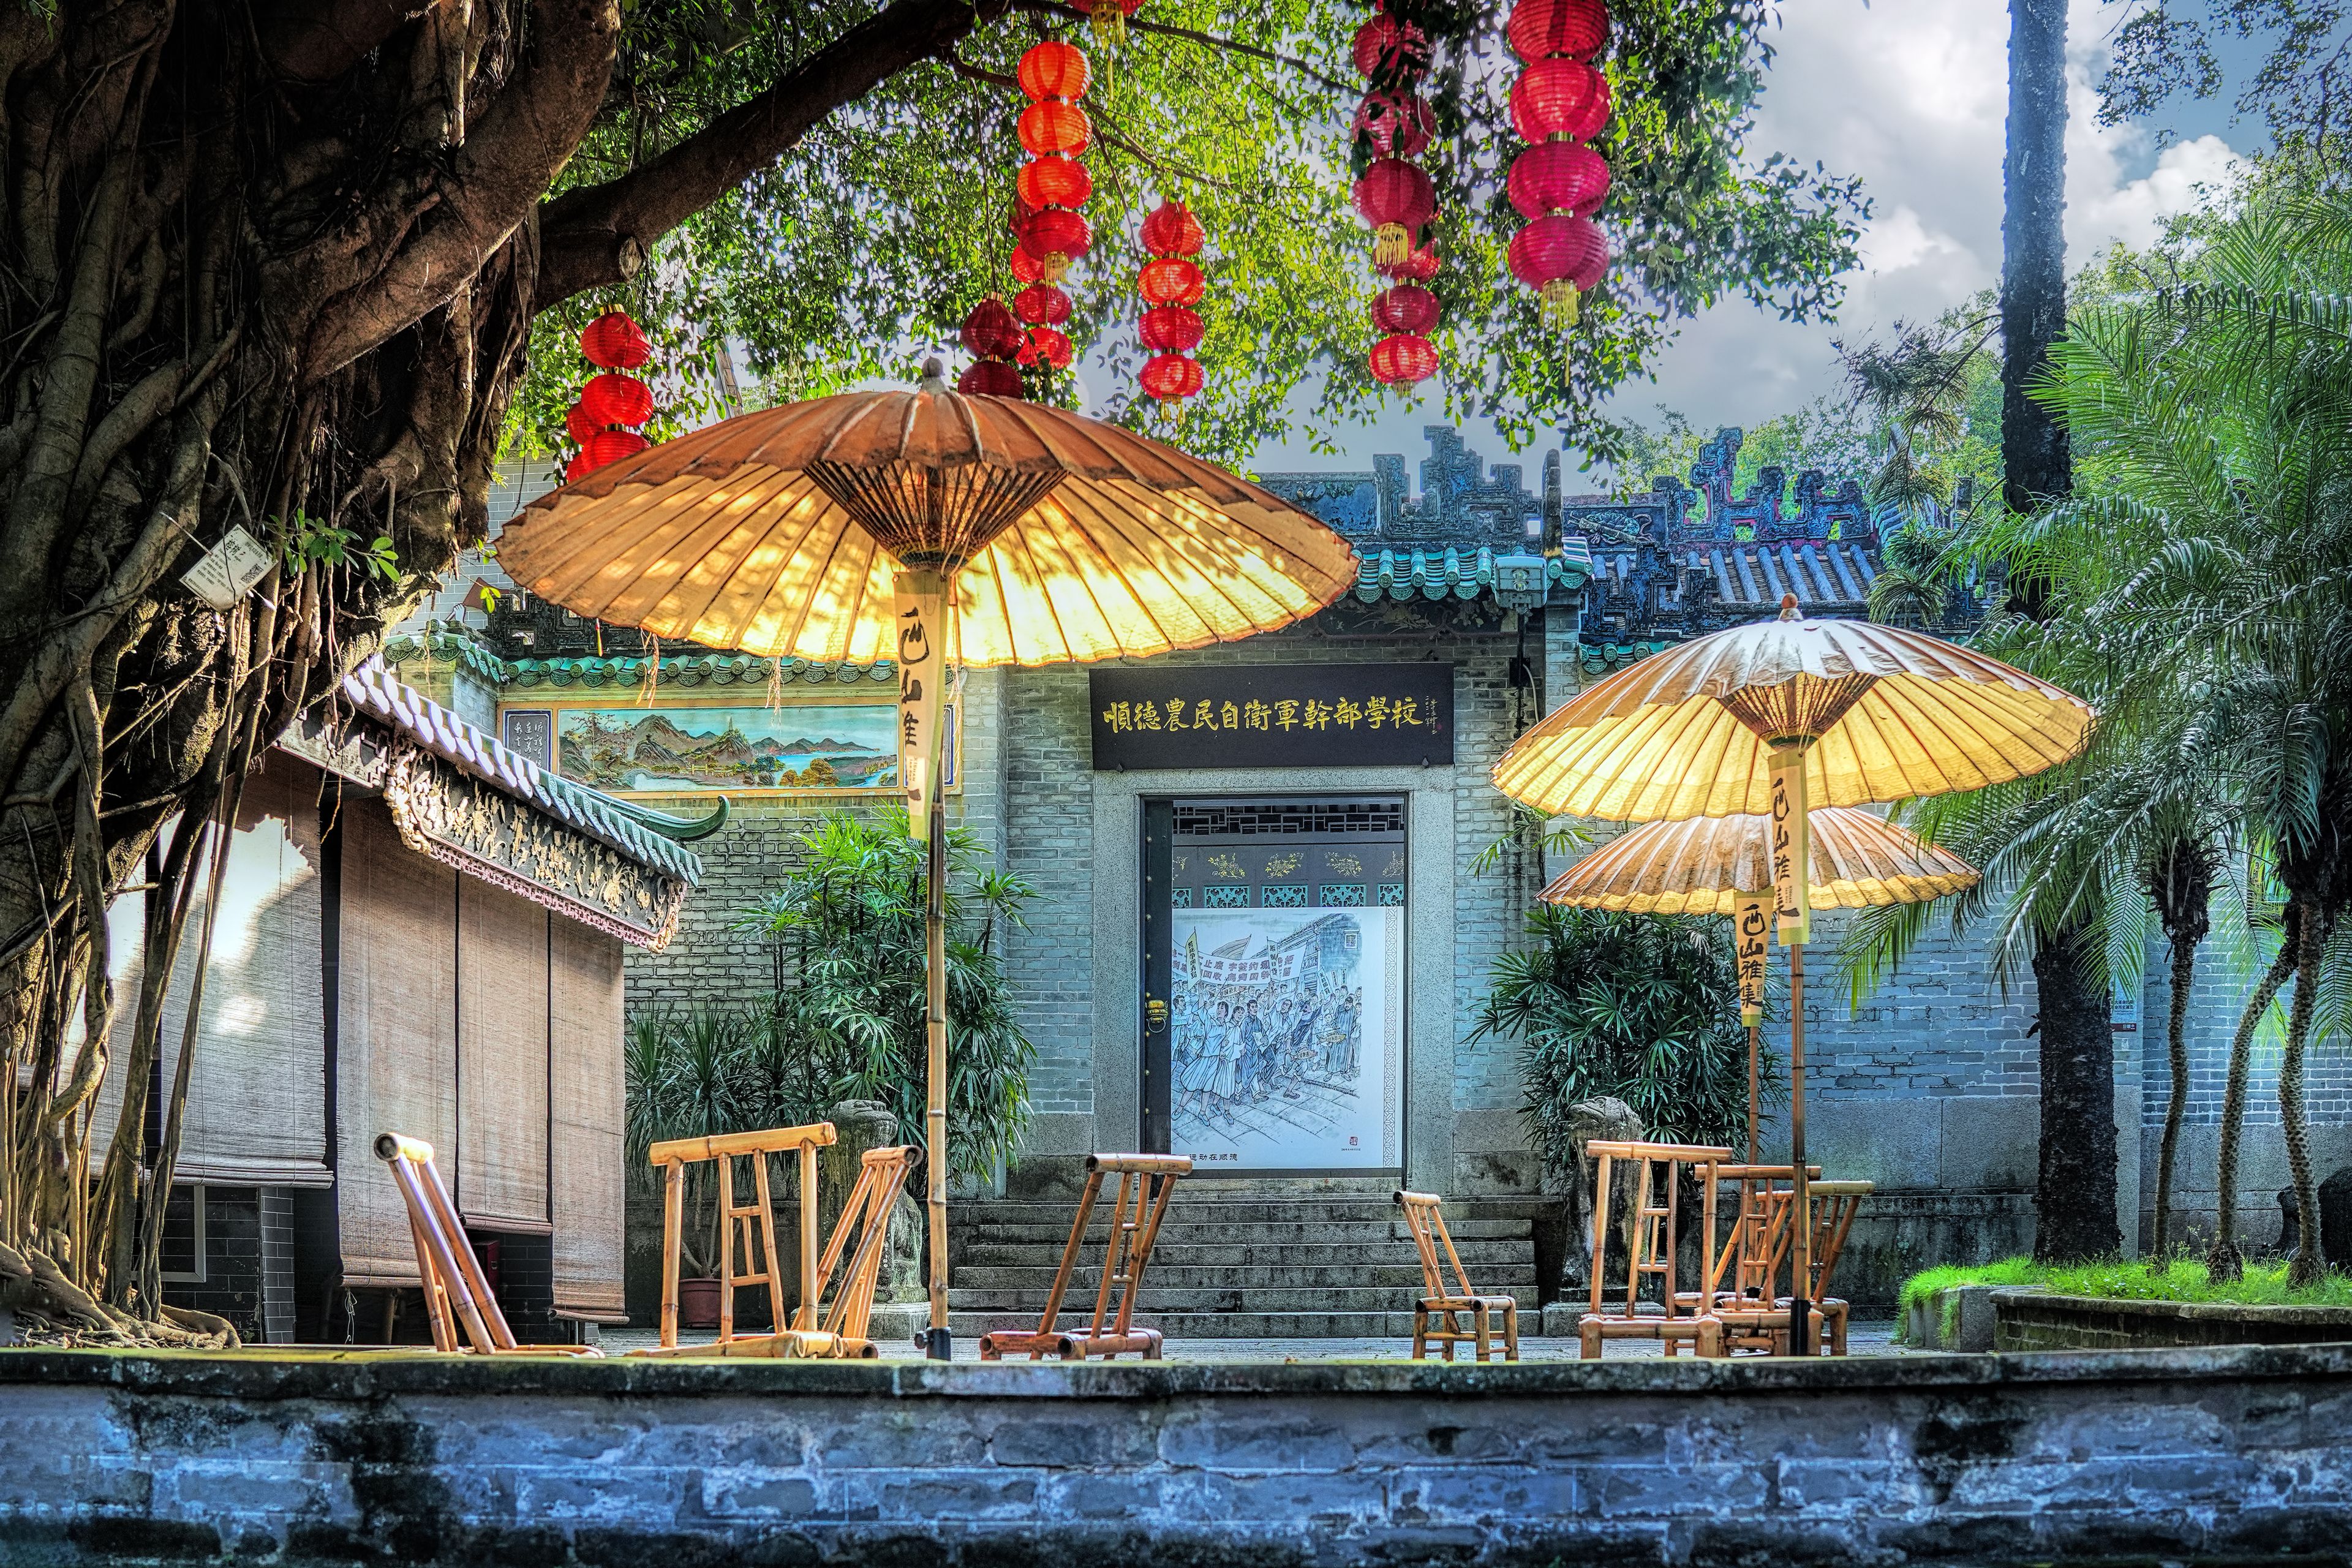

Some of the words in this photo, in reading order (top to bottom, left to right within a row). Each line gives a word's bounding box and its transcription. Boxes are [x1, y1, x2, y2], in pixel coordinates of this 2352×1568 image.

[1102, 695, 1424, 732] 順德農民自衛軍幹部學校
[1738, 903, 1766, 1009] 西山雅集
